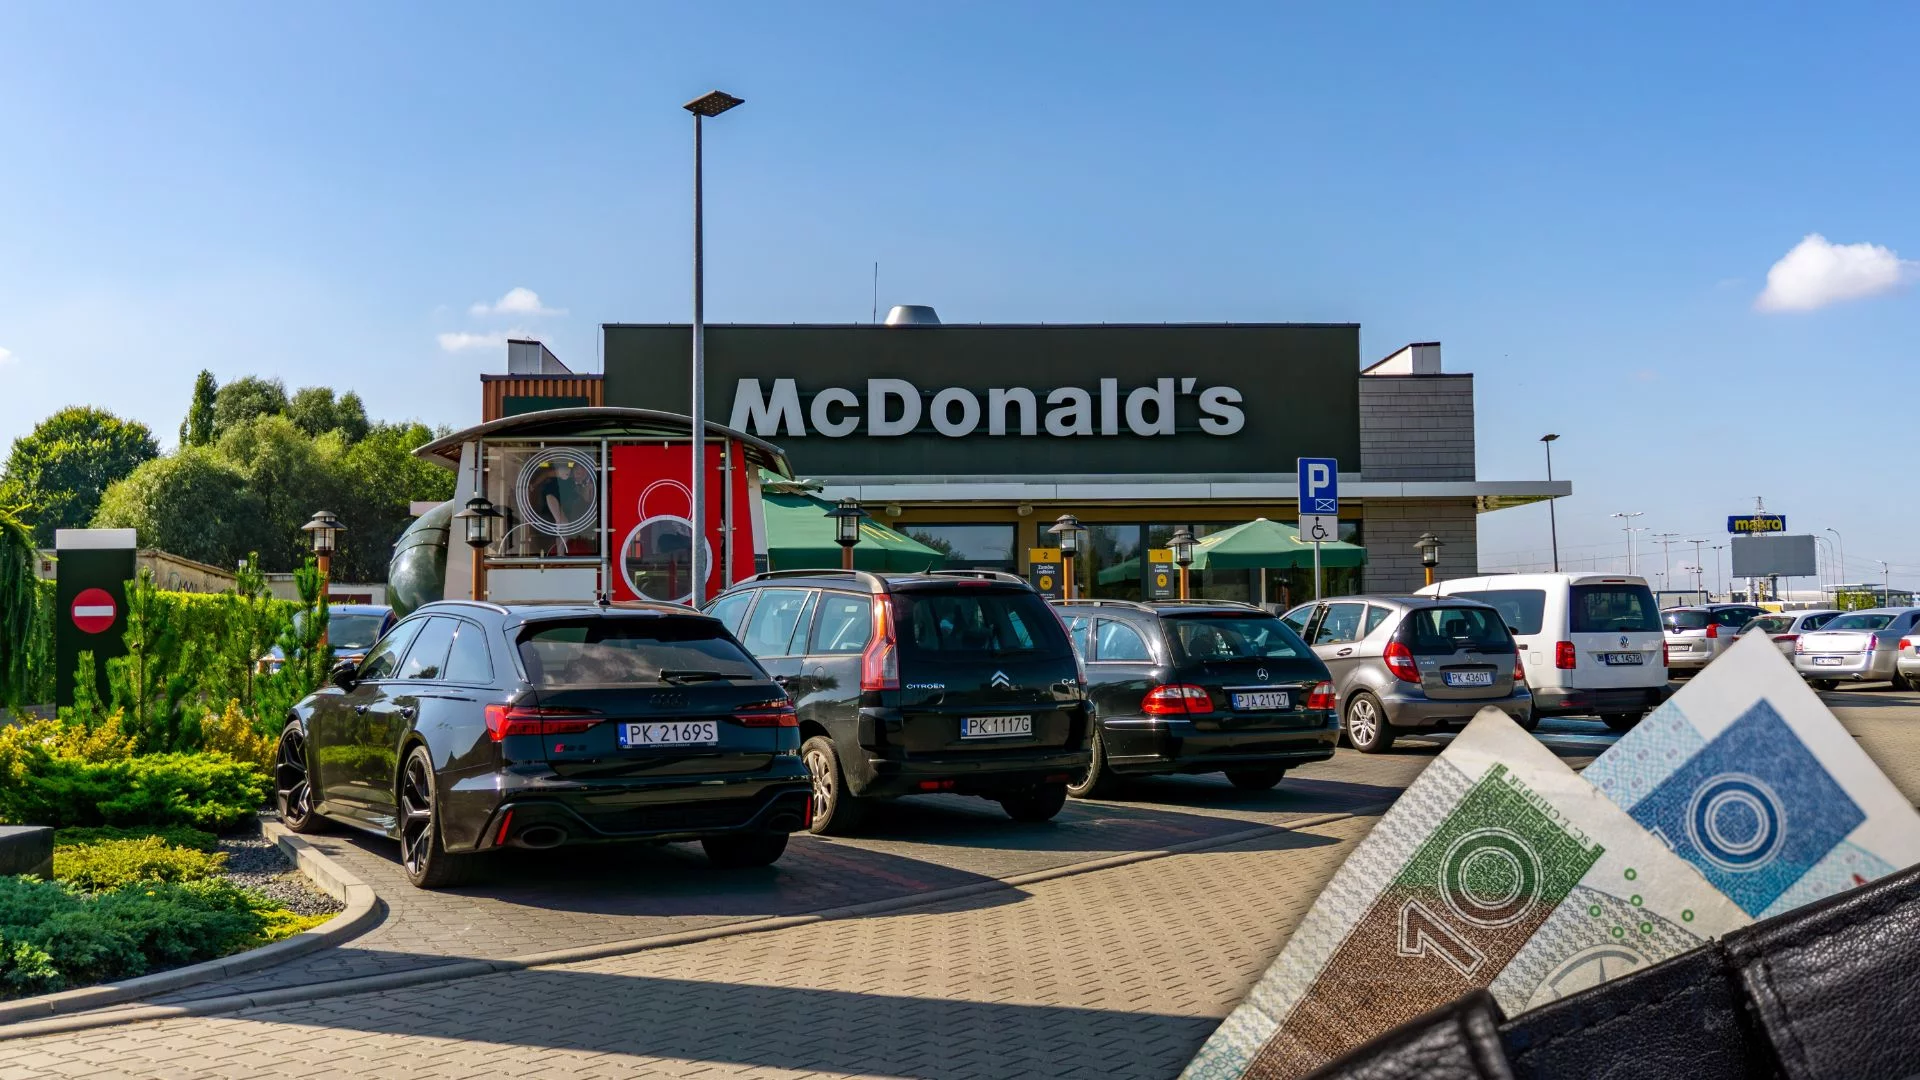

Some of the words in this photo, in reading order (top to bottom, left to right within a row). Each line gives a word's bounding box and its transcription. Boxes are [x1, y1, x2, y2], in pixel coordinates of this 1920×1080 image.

[728, 377, 1245, 437] McDonald's
[1308, 463, 1330, 498] P
[1735, 517, 1781, 530] makro
[1043, 551, 1049, 560] 2
[1061, 678, 1077, 686] C4
[1452, 673, 1464, 683] PK
[1237, 694, 1258, 707] PJA
[1260, 693, 1288, 706] 21127
[629, 724, 653, 743] PK
[660, 722, 714, 742] 2169S
[969, 720, 988, 734] PK
[994, 715, 1029, 733] 1117G
[1508, 773, 1561, 821] CHIPPER
[1396, 826, 1544, 981] 10
